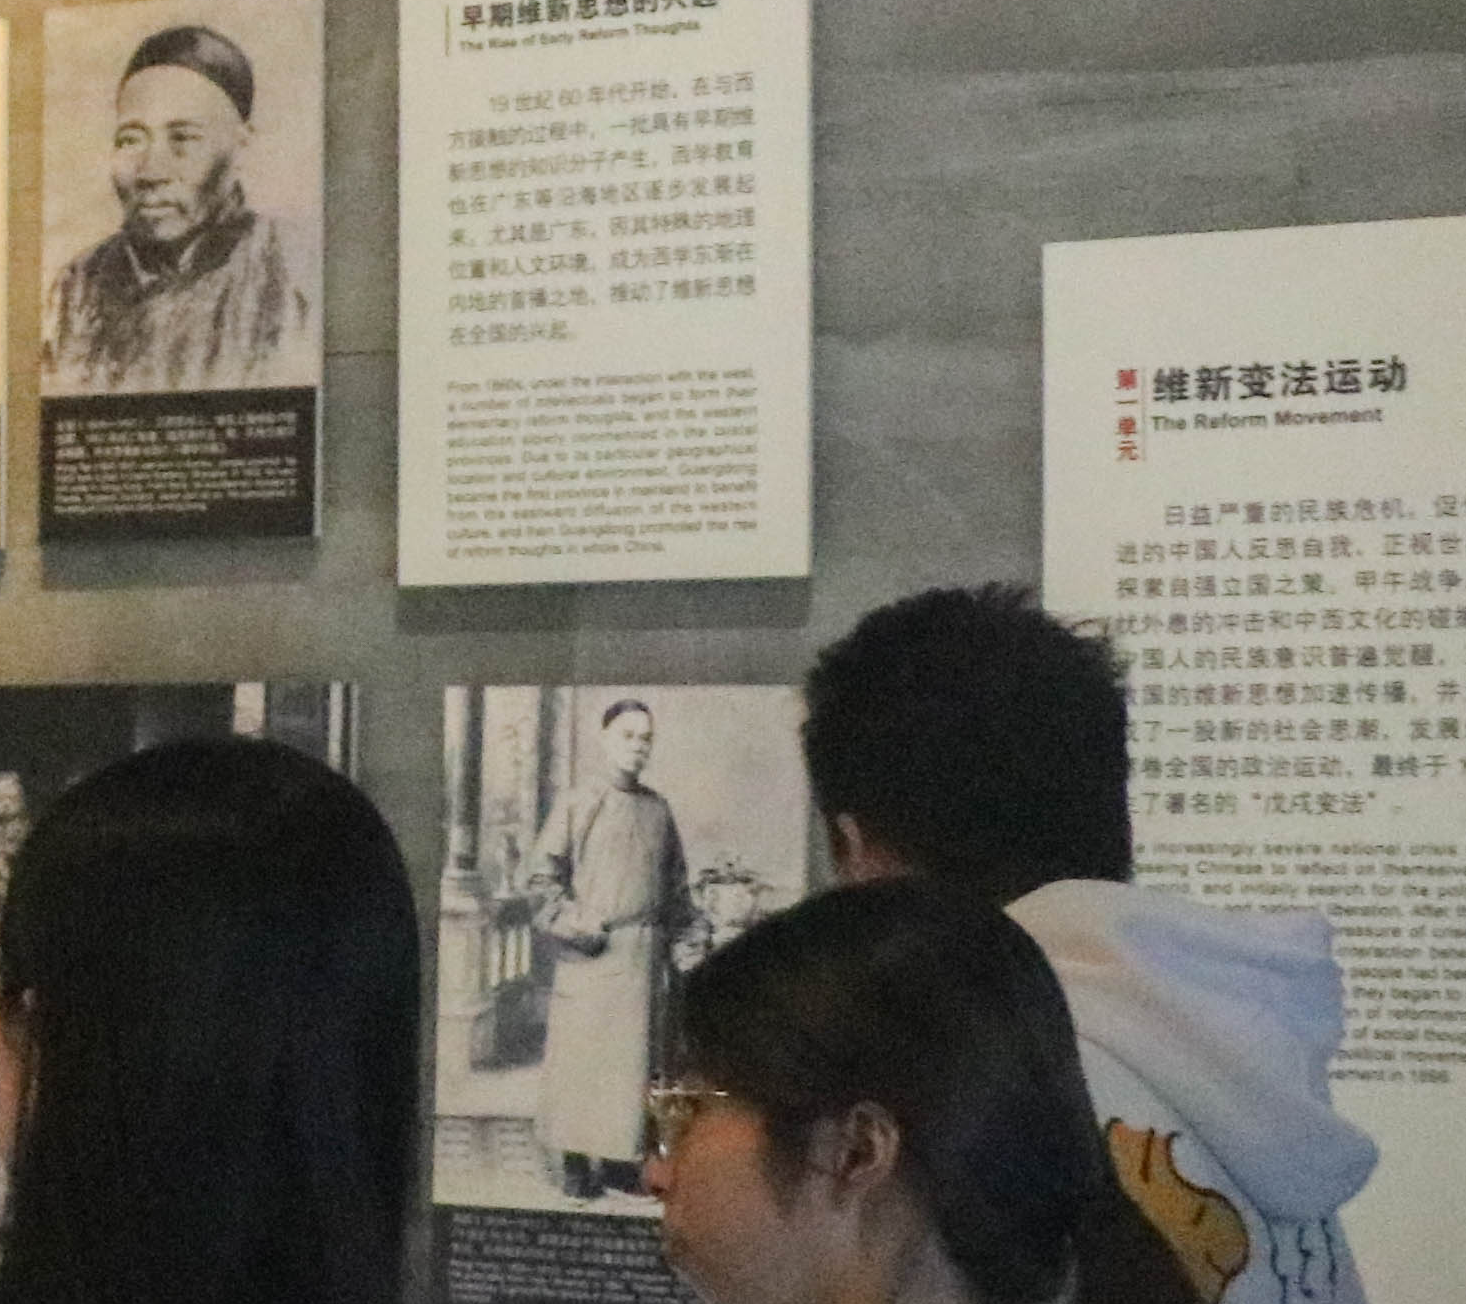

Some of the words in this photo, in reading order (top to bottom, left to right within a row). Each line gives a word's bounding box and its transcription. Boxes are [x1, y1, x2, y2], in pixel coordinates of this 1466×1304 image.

[460, 38, 483, 51] The
[579, 26, 628, 41] Reform
[1153, 355, 1408, 404] 维新变法运动
[1115, 368, 1140, 462] 第一单元
[1151, 414, 1186, 432] The
[1193, 412, 1268, 430] Reform
[1274, 407, 1384, 427] Movement
